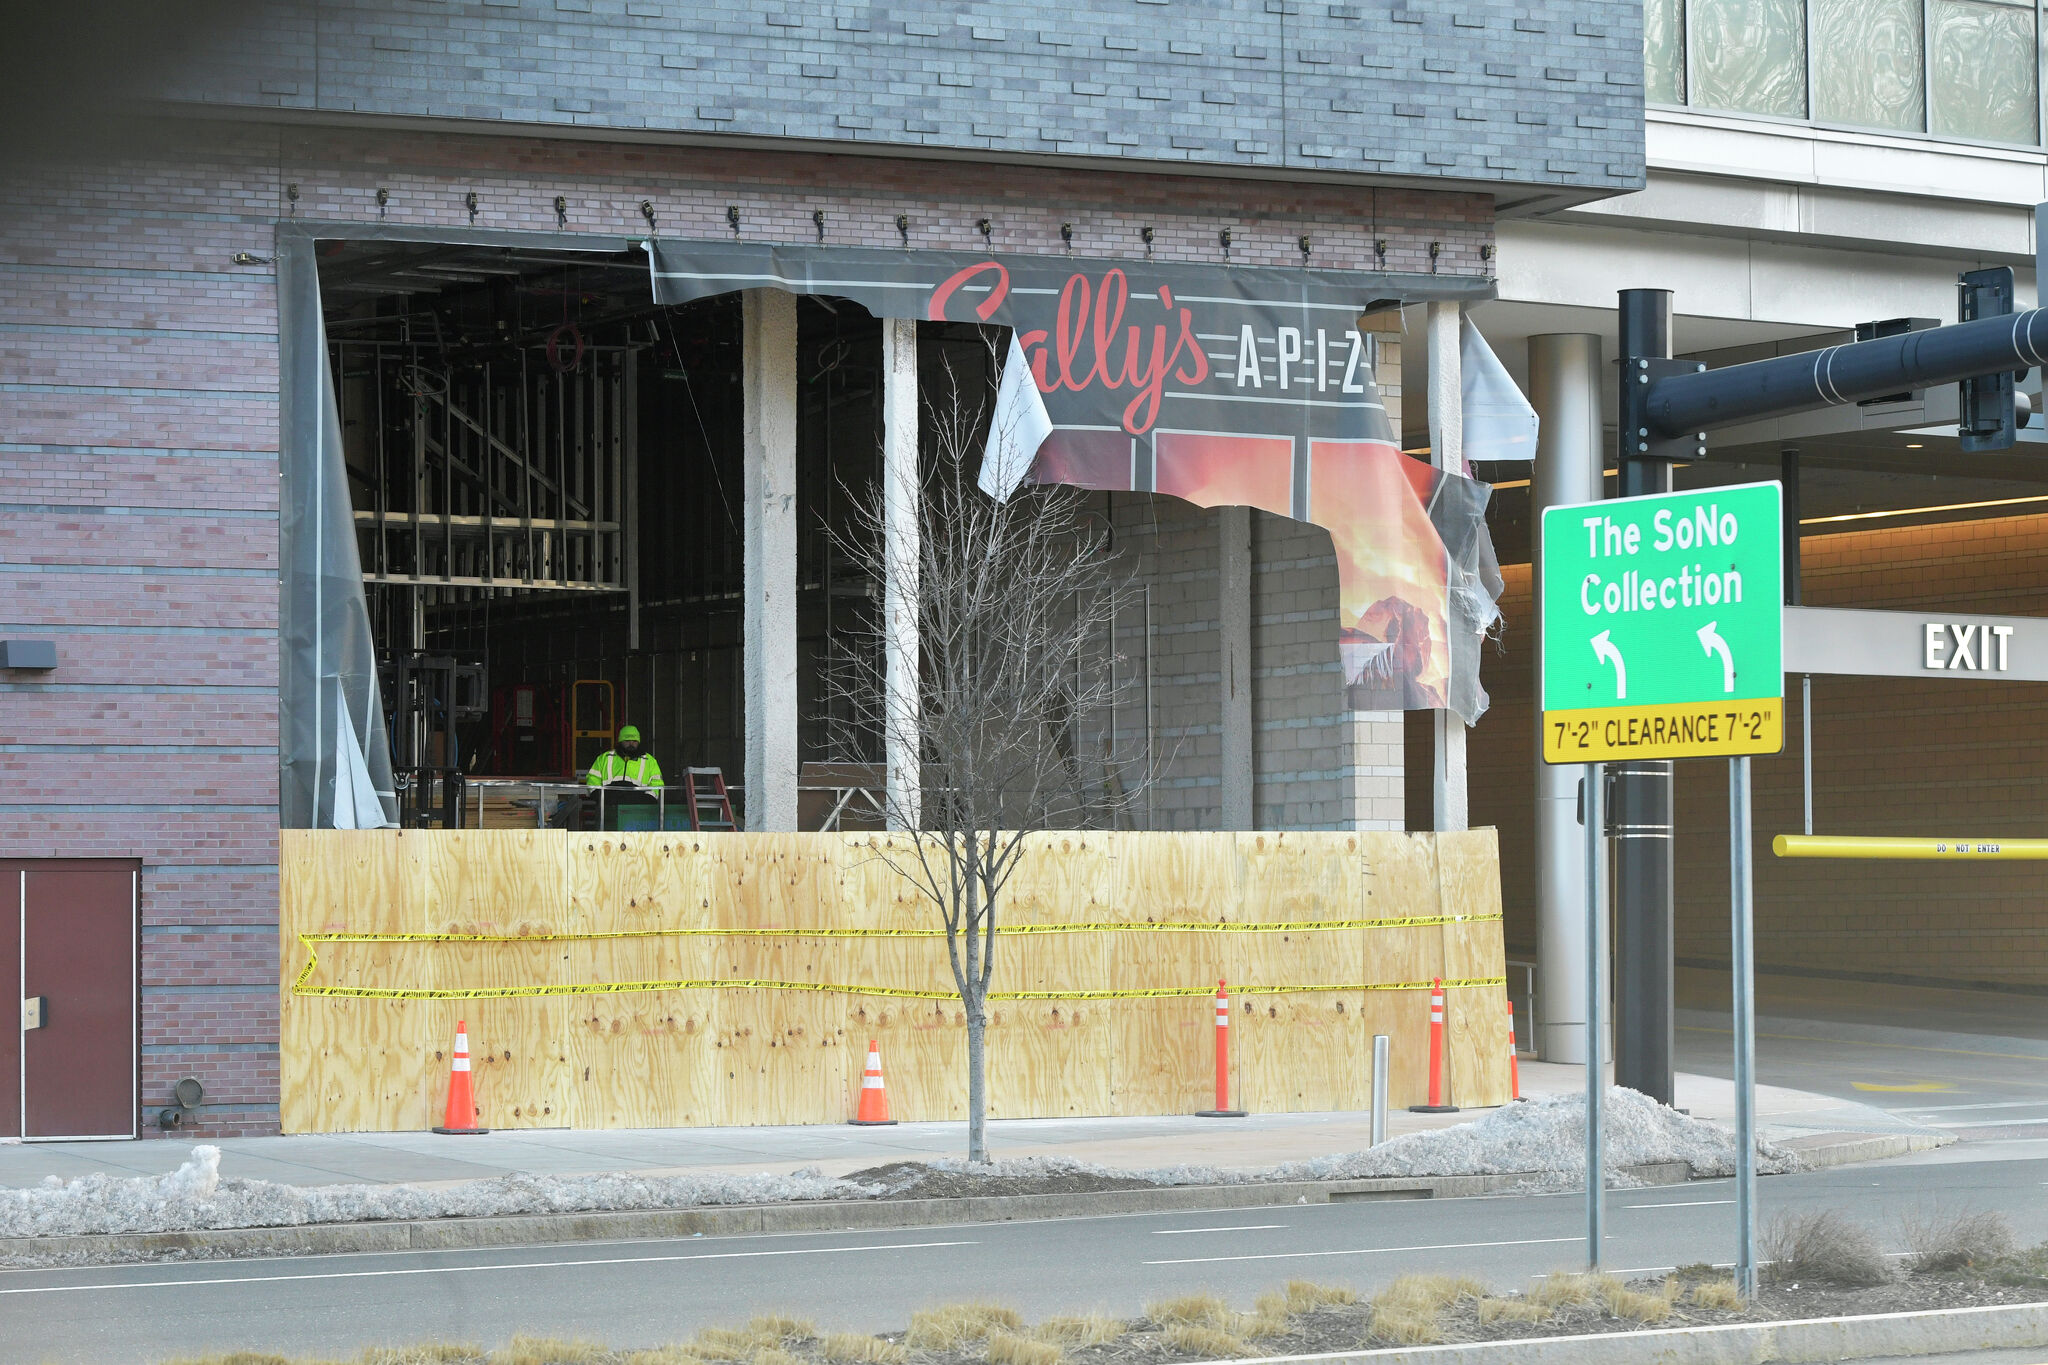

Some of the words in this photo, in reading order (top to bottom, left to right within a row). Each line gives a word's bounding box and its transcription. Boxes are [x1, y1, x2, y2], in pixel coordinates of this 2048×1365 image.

[1237, 324, 1363, 393] APIZ
[1583, 515, 1641, 558] The
[1653, 504, 1738, 552] SoNo
[1581, 563, 1742, 616] Collection
[1923, 623, 2013, 671] EXIT
[1554, 720, 1598, 749] 7'-2"
[1605, 714, 1719, 747] CLEARANCE
[1725, 711, 1771, 740] 7'-2"
[1937, 844, 1947, 853] DO
[1955, 844, 1969, 853] NOT
[1977, 844, 2000, 853] ENTER
